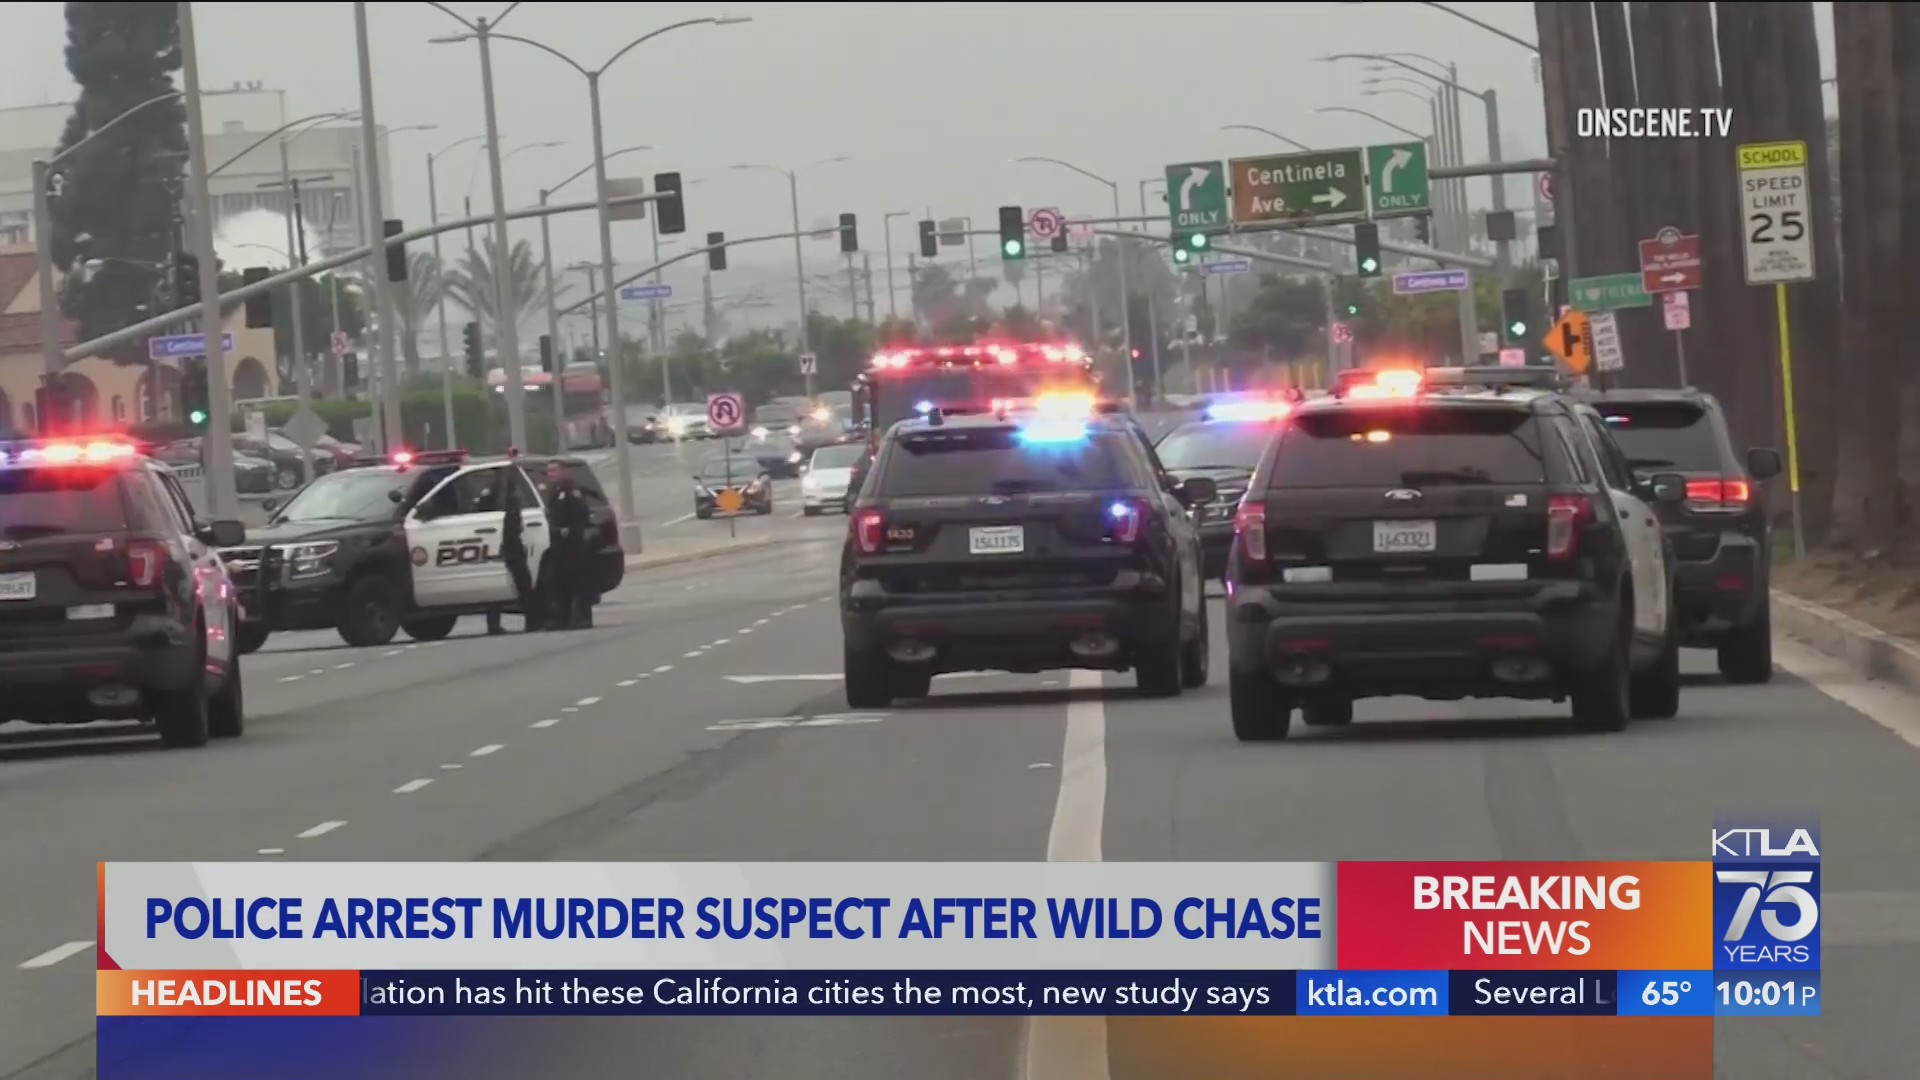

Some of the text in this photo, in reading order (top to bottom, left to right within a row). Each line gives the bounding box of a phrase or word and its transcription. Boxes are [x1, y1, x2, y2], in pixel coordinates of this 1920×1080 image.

[1742, 149, 1801, 164] SCHOOL
[1247, 162, 1346, 187] Centinela
[1745, 175, 1803, 192] SPEED
[1379, 194, 1421, 208] ONLY
[1753, 193, 1797, 209] LIMIT
[1178, 210, 1219, 226] ONLY
[1749, 211, 1805, 243] 25
